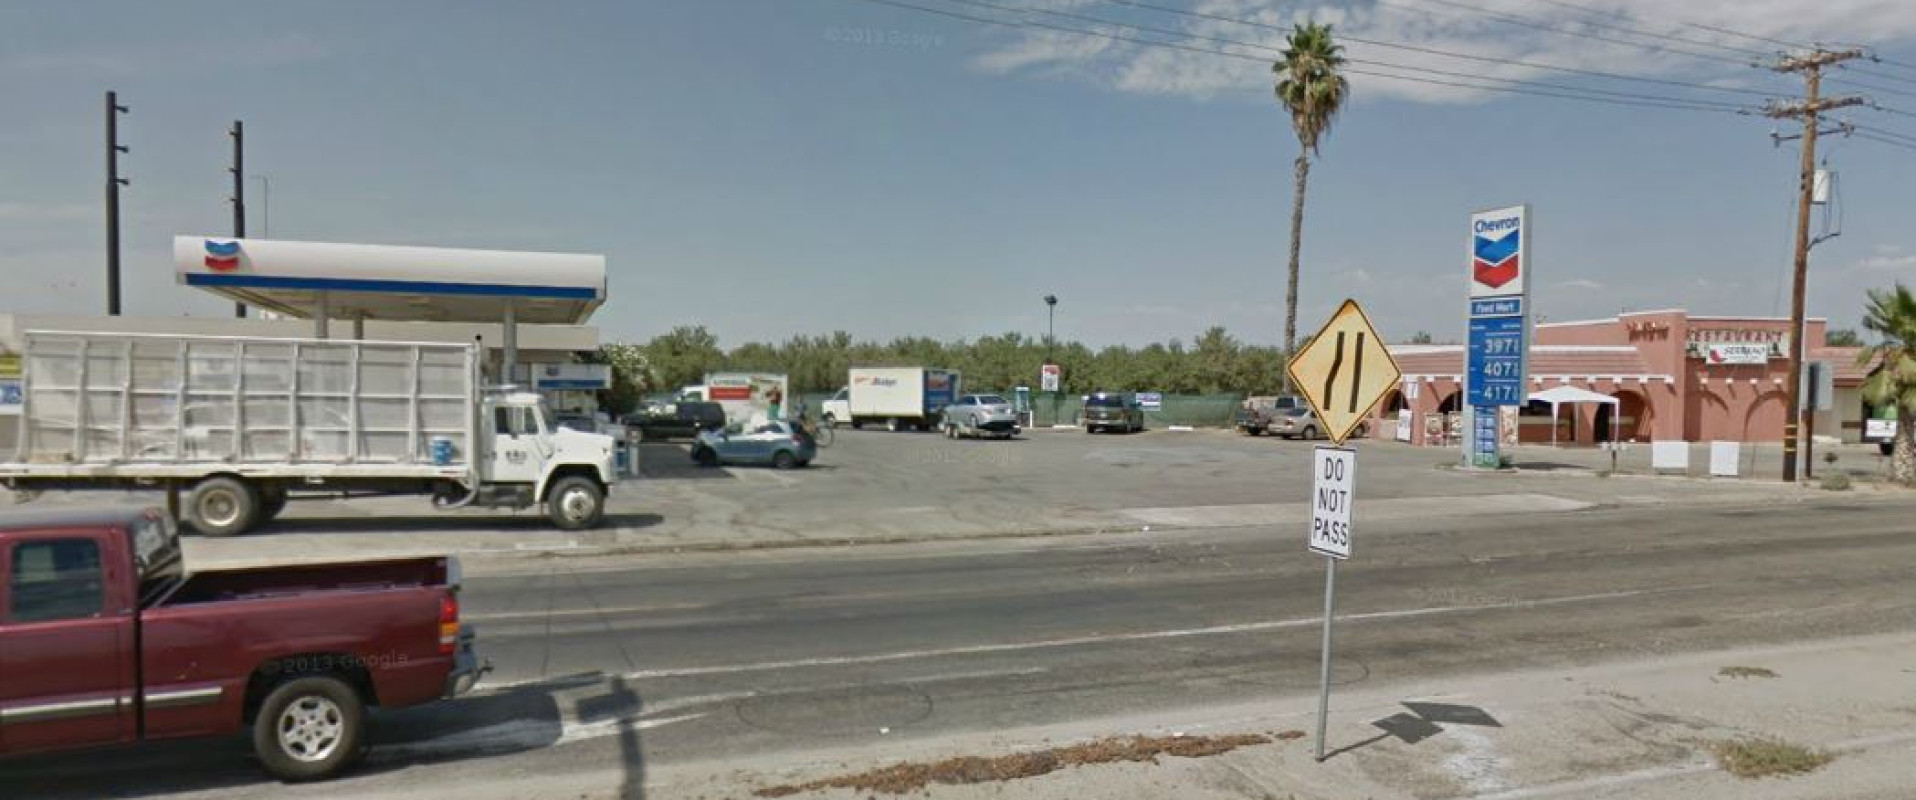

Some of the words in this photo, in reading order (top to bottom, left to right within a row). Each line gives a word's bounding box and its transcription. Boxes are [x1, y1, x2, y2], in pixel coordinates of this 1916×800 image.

[1475, 217, 1520, 232] Chevron
[1687, 329, 1784, 342] RESTAURANT
[1325, 457, 1344, 482] DO
[1318, 487, 1346, 514] NOT
[1313, 517, 1347, 547] PASS
